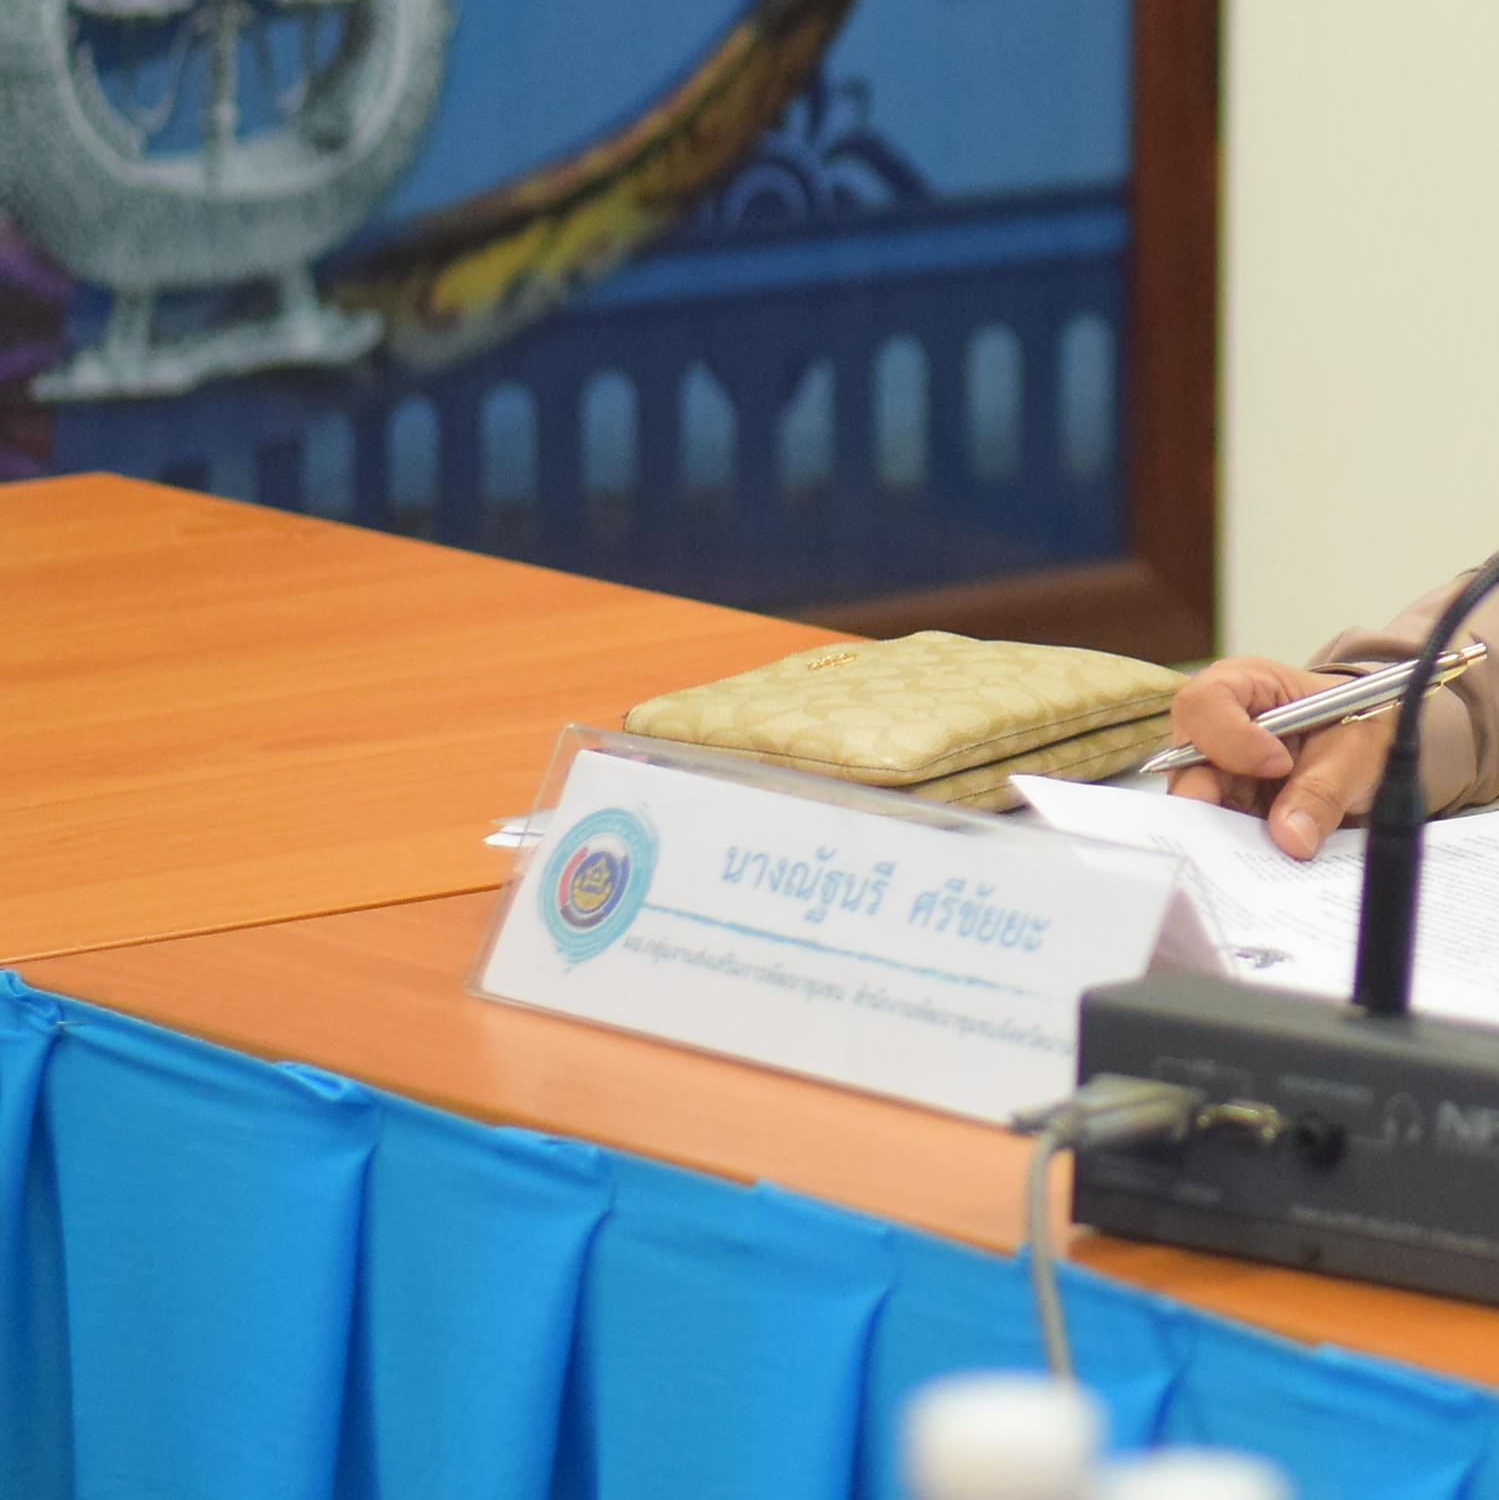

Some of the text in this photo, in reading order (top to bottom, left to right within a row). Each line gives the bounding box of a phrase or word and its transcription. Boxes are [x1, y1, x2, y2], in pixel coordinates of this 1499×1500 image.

[721, 846, 897, 924] นางณัฐนรี
[907, 877, 1051, 952] ศรีชัยยะ
